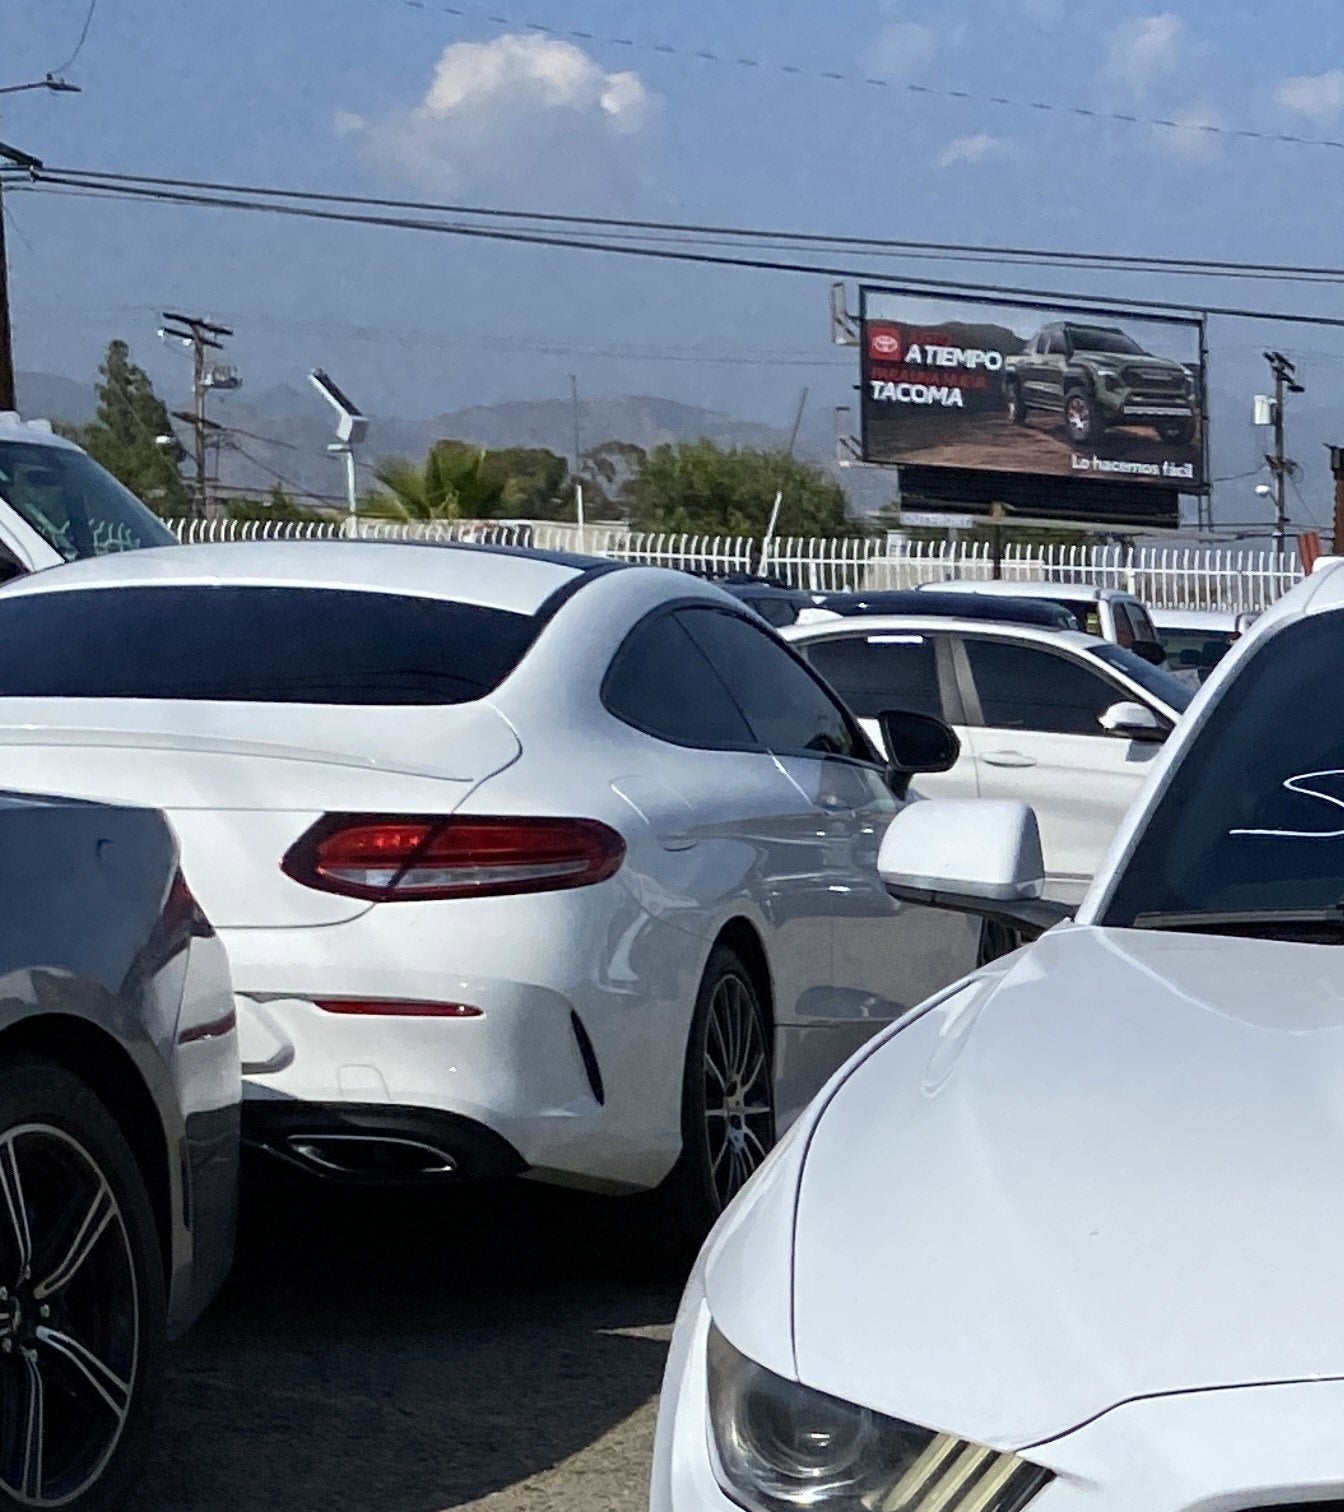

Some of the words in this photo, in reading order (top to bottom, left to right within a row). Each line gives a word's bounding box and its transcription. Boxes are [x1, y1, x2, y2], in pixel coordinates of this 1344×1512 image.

[905, 343, 922, 364] A
[870, 380, 964, 408] TACOMA
[1071, 453, 1090, 469] Lo
